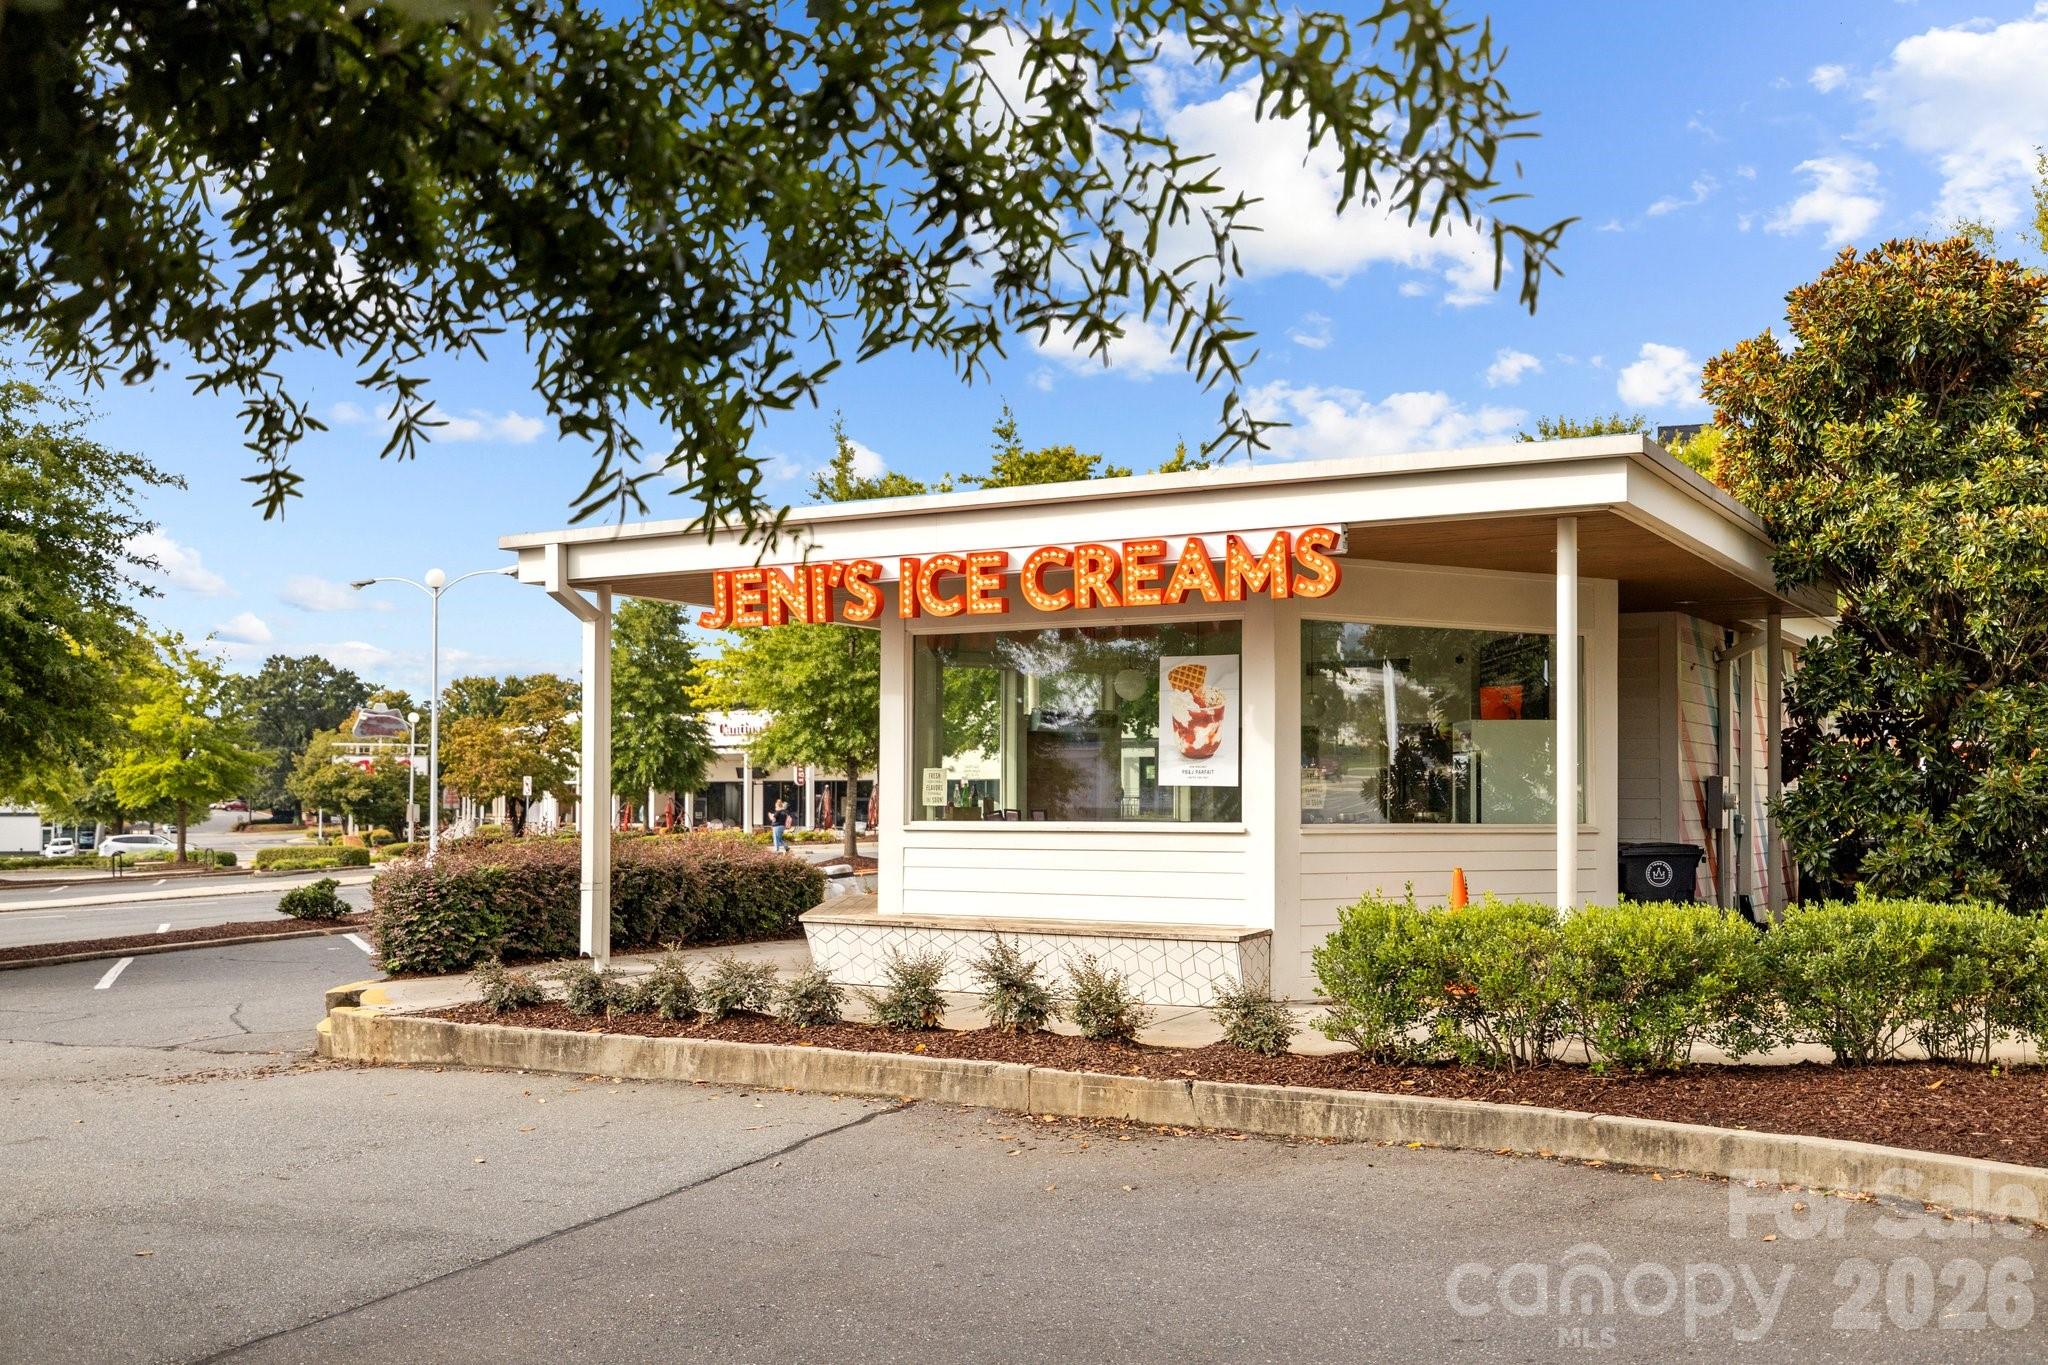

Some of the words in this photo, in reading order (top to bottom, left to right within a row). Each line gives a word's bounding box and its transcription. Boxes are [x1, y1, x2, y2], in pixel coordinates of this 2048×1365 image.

[697, 560, 885, 630] JENI'S
[899, 551, 1009, 619] ICE
[1020, 527, 1342, 611] CREAMS
